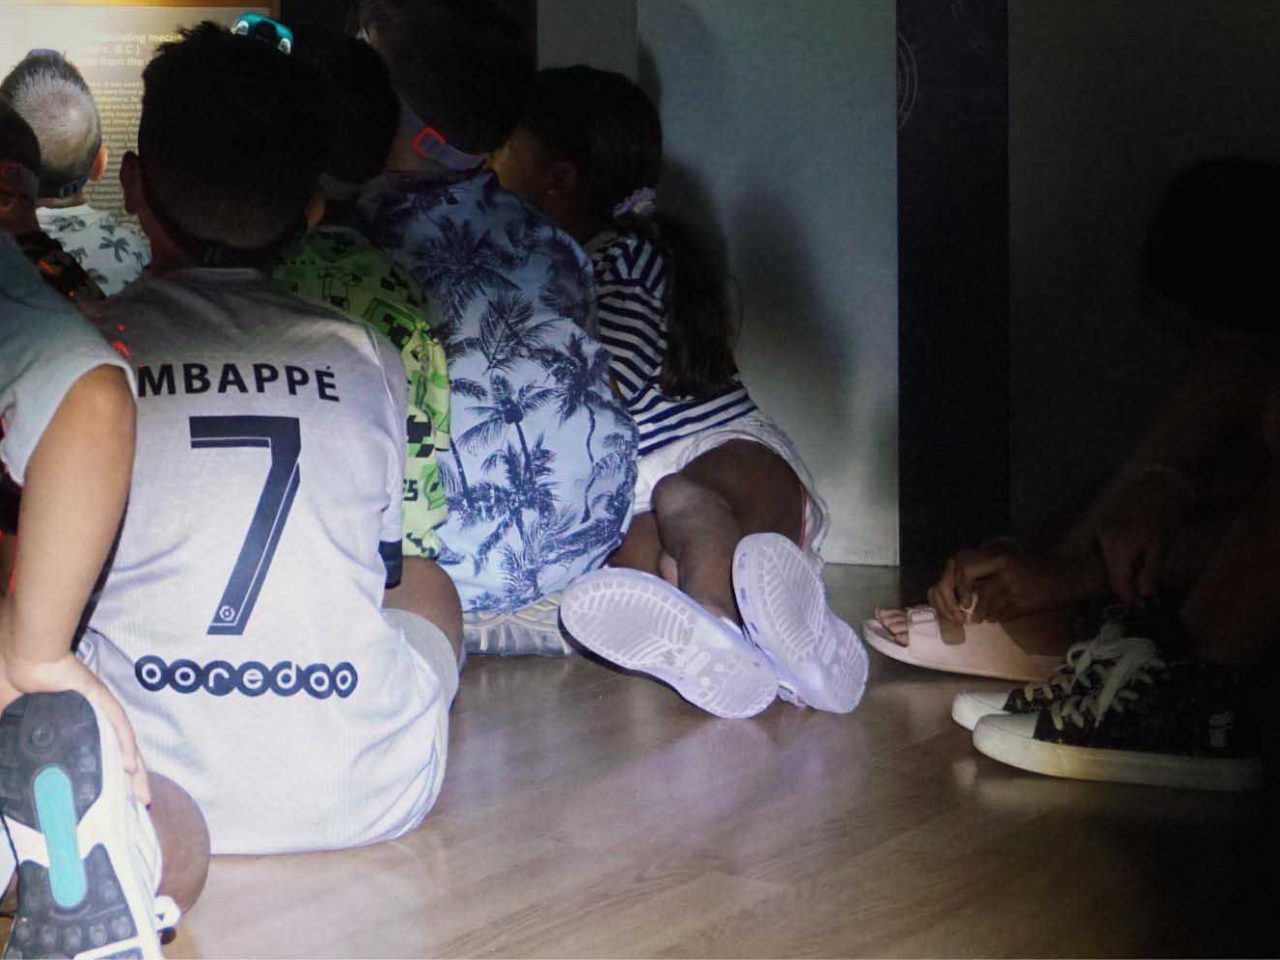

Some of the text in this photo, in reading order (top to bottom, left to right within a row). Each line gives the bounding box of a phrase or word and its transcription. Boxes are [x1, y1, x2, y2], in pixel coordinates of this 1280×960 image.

[138, 362, 341, 403] MBAPPÉ
[189, 415, 301, 636] 7
[135, 654, 359, 700] ooredoo
